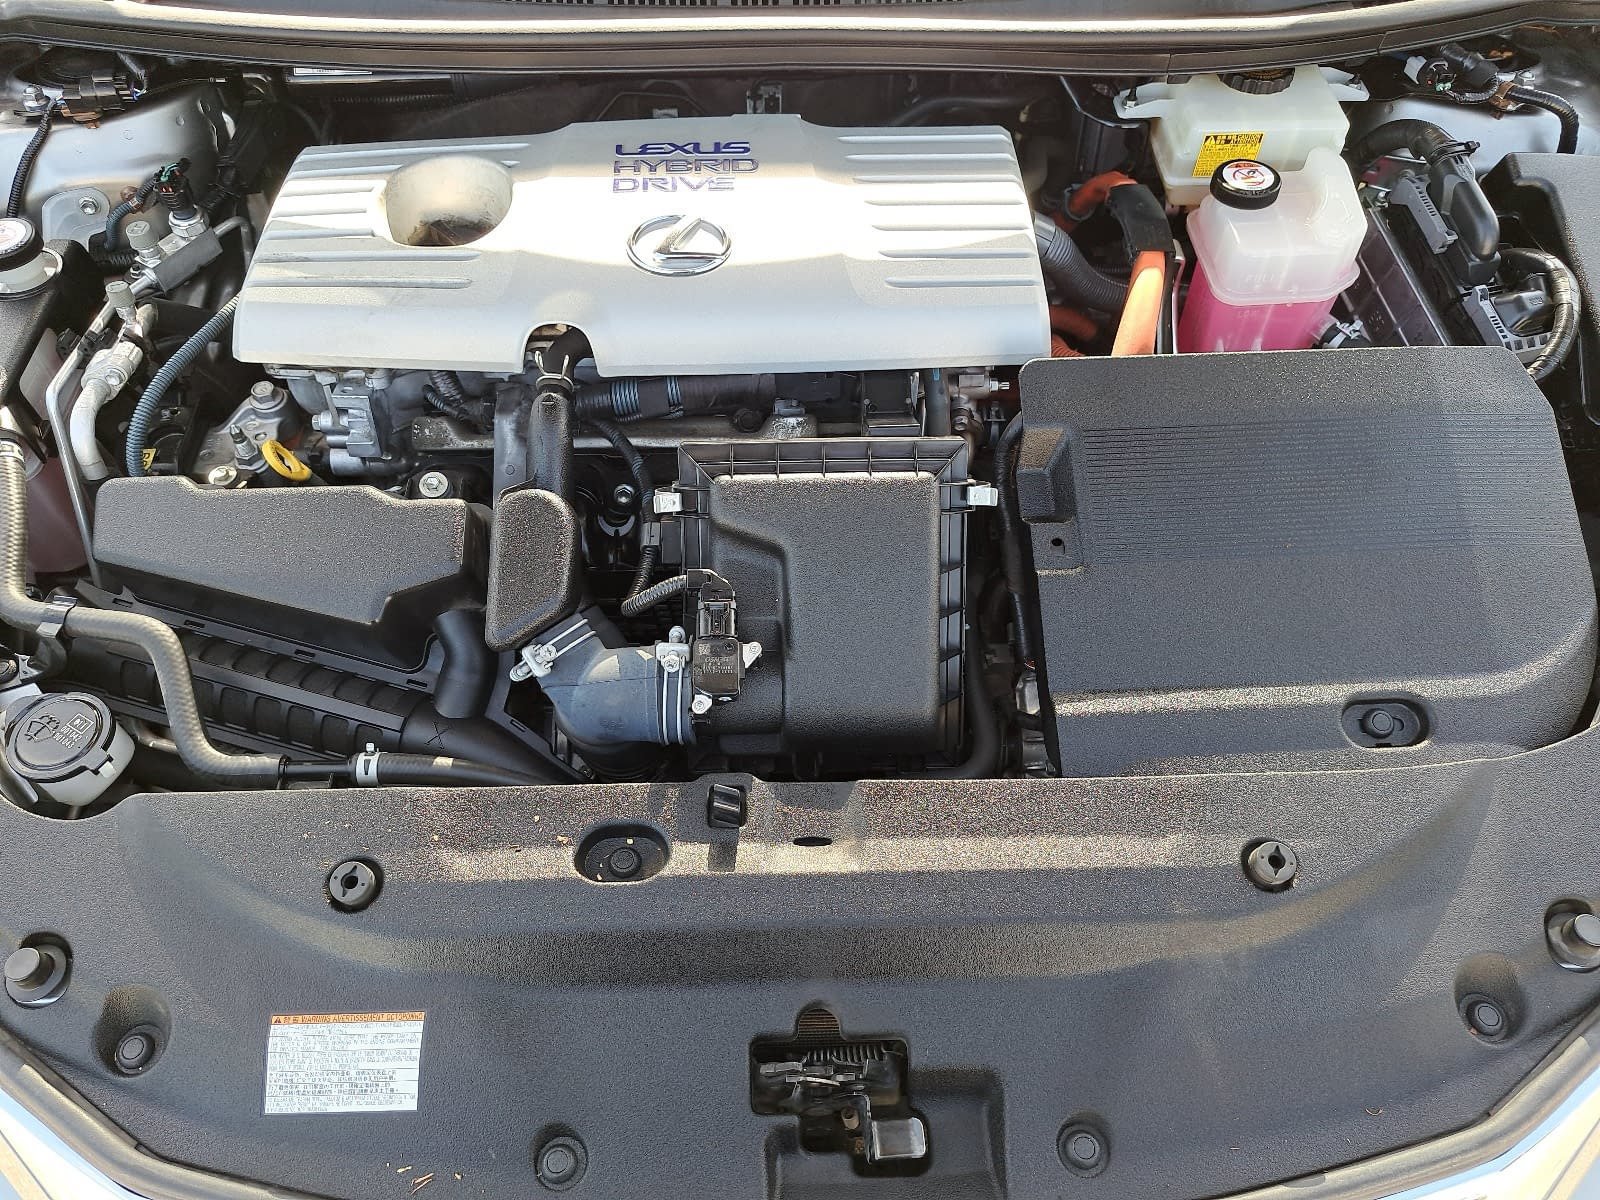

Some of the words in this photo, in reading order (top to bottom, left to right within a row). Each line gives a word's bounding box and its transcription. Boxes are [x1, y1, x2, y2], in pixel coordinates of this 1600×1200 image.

[615, 141, 751, 156] LEXUS
[613, 159, 759, 175] HYBRID
[612, 176, 736, 193] DRIVE
[302, 1014, 330, 1023] WARNING
